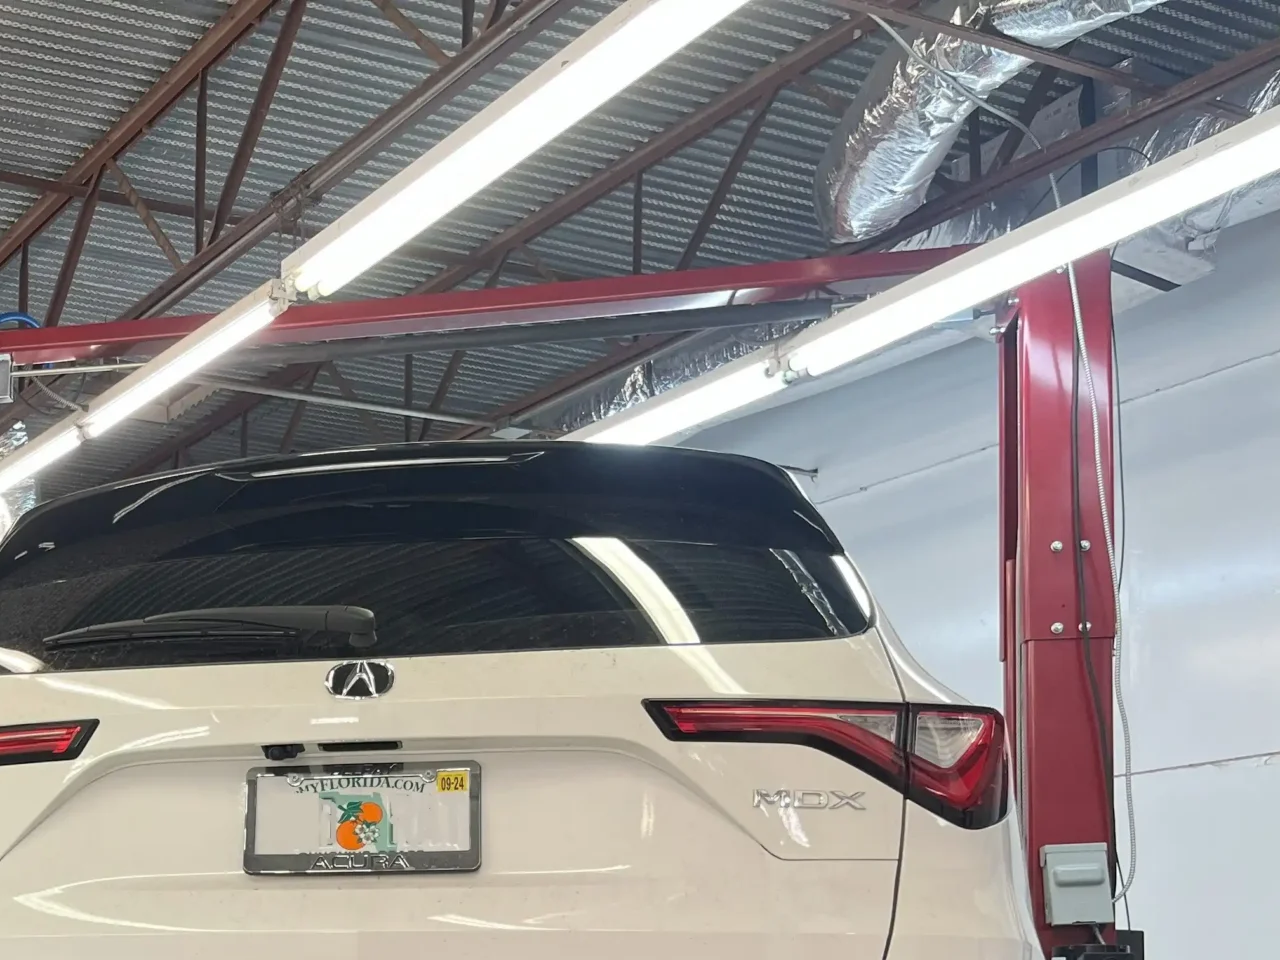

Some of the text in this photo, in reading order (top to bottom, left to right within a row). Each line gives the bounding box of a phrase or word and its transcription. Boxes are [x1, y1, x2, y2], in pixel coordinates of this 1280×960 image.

[440, 776, 465, 791] 09-24
[752, 788, 867, 811] MDX
[310, 854, 414, 870] ACURA
